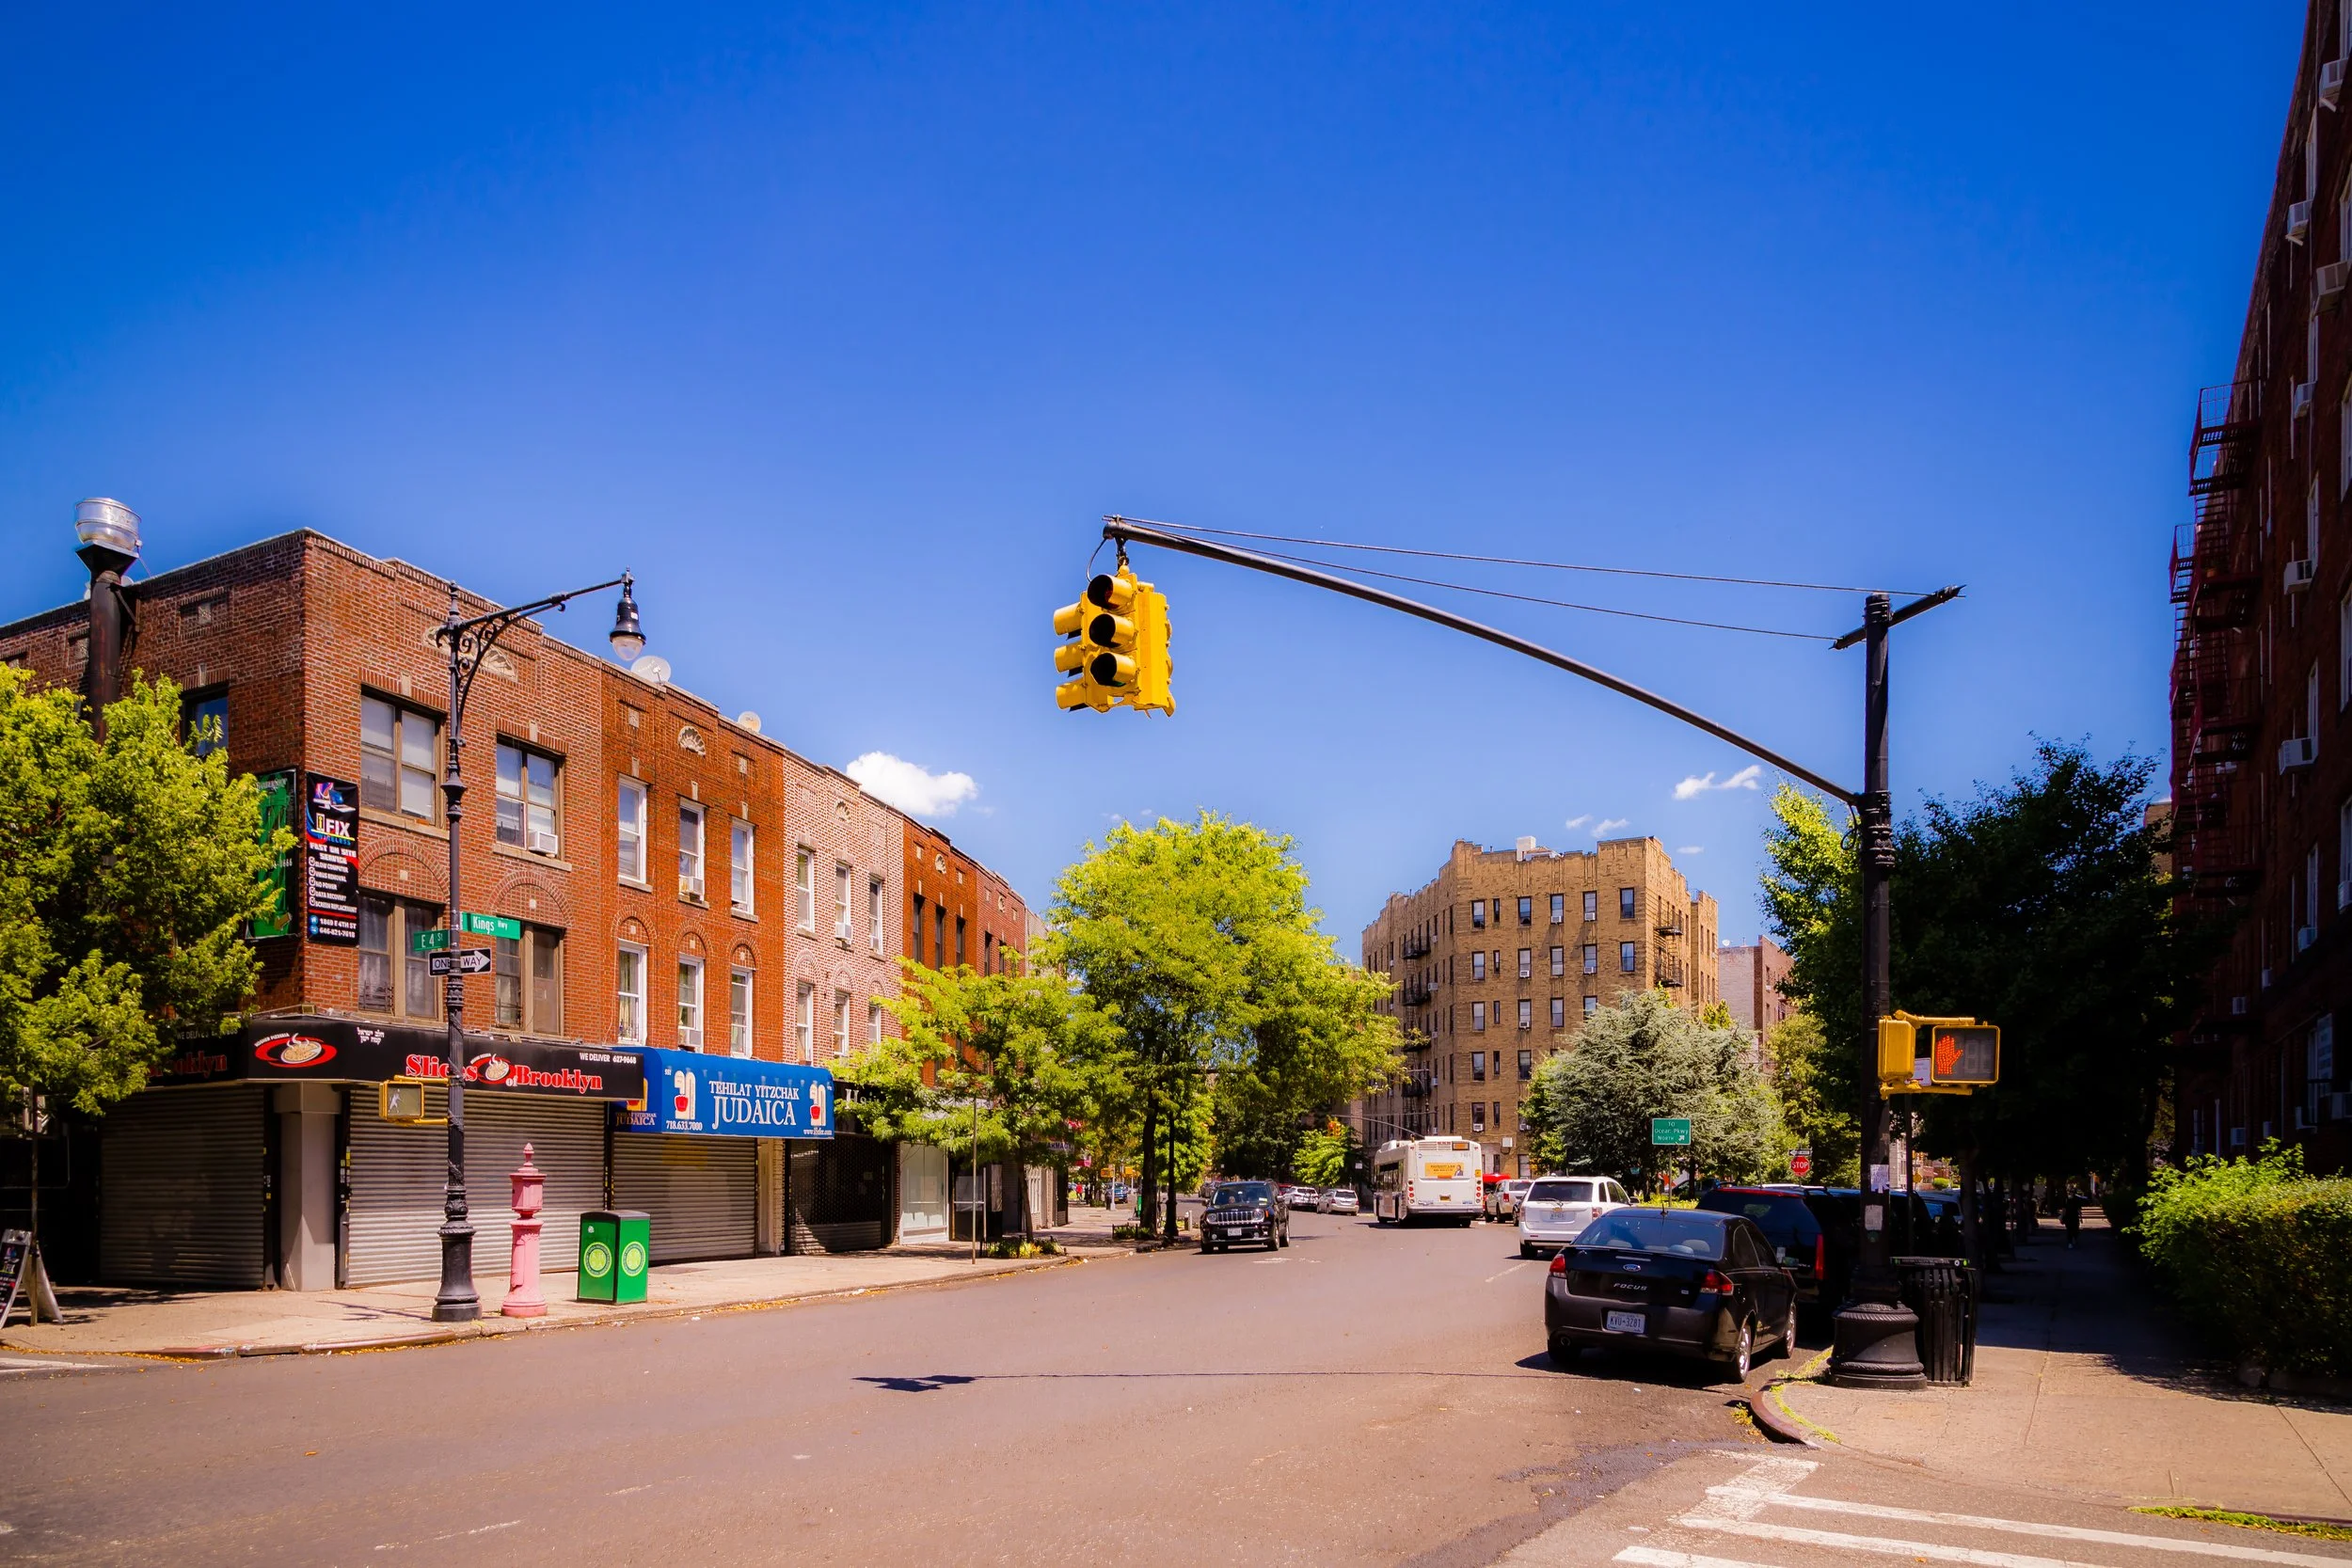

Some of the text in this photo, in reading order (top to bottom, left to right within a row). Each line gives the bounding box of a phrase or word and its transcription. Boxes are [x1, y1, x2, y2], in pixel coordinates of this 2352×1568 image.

[310, 842, 327, 852] FAST
[320, 852, 347, 864] SERVICE
[323, 882, 338, 891] POWER
[339, 921, 349, 929] 4TH
[472, 915, 508, 935] Kings Hwy
[421, 932, 443, 948] E 4 St
[463, 957, 483, 967] WAY
[580, 1052, 589, 1061] WE
[589, 1053, 611, 1063] DELIVER
[506, 1075, 517, 1087] of
[514, 1064, 603, 1094] Brooklyn
[708, 1080, 800, 1101] TEHILAT YITZCHAK
[711, 1095, 797, 1130] JUDAICA
[616, 1117, 656, 1128] JUDAICA
[1791, 1161, 1808, 1169] STOP
